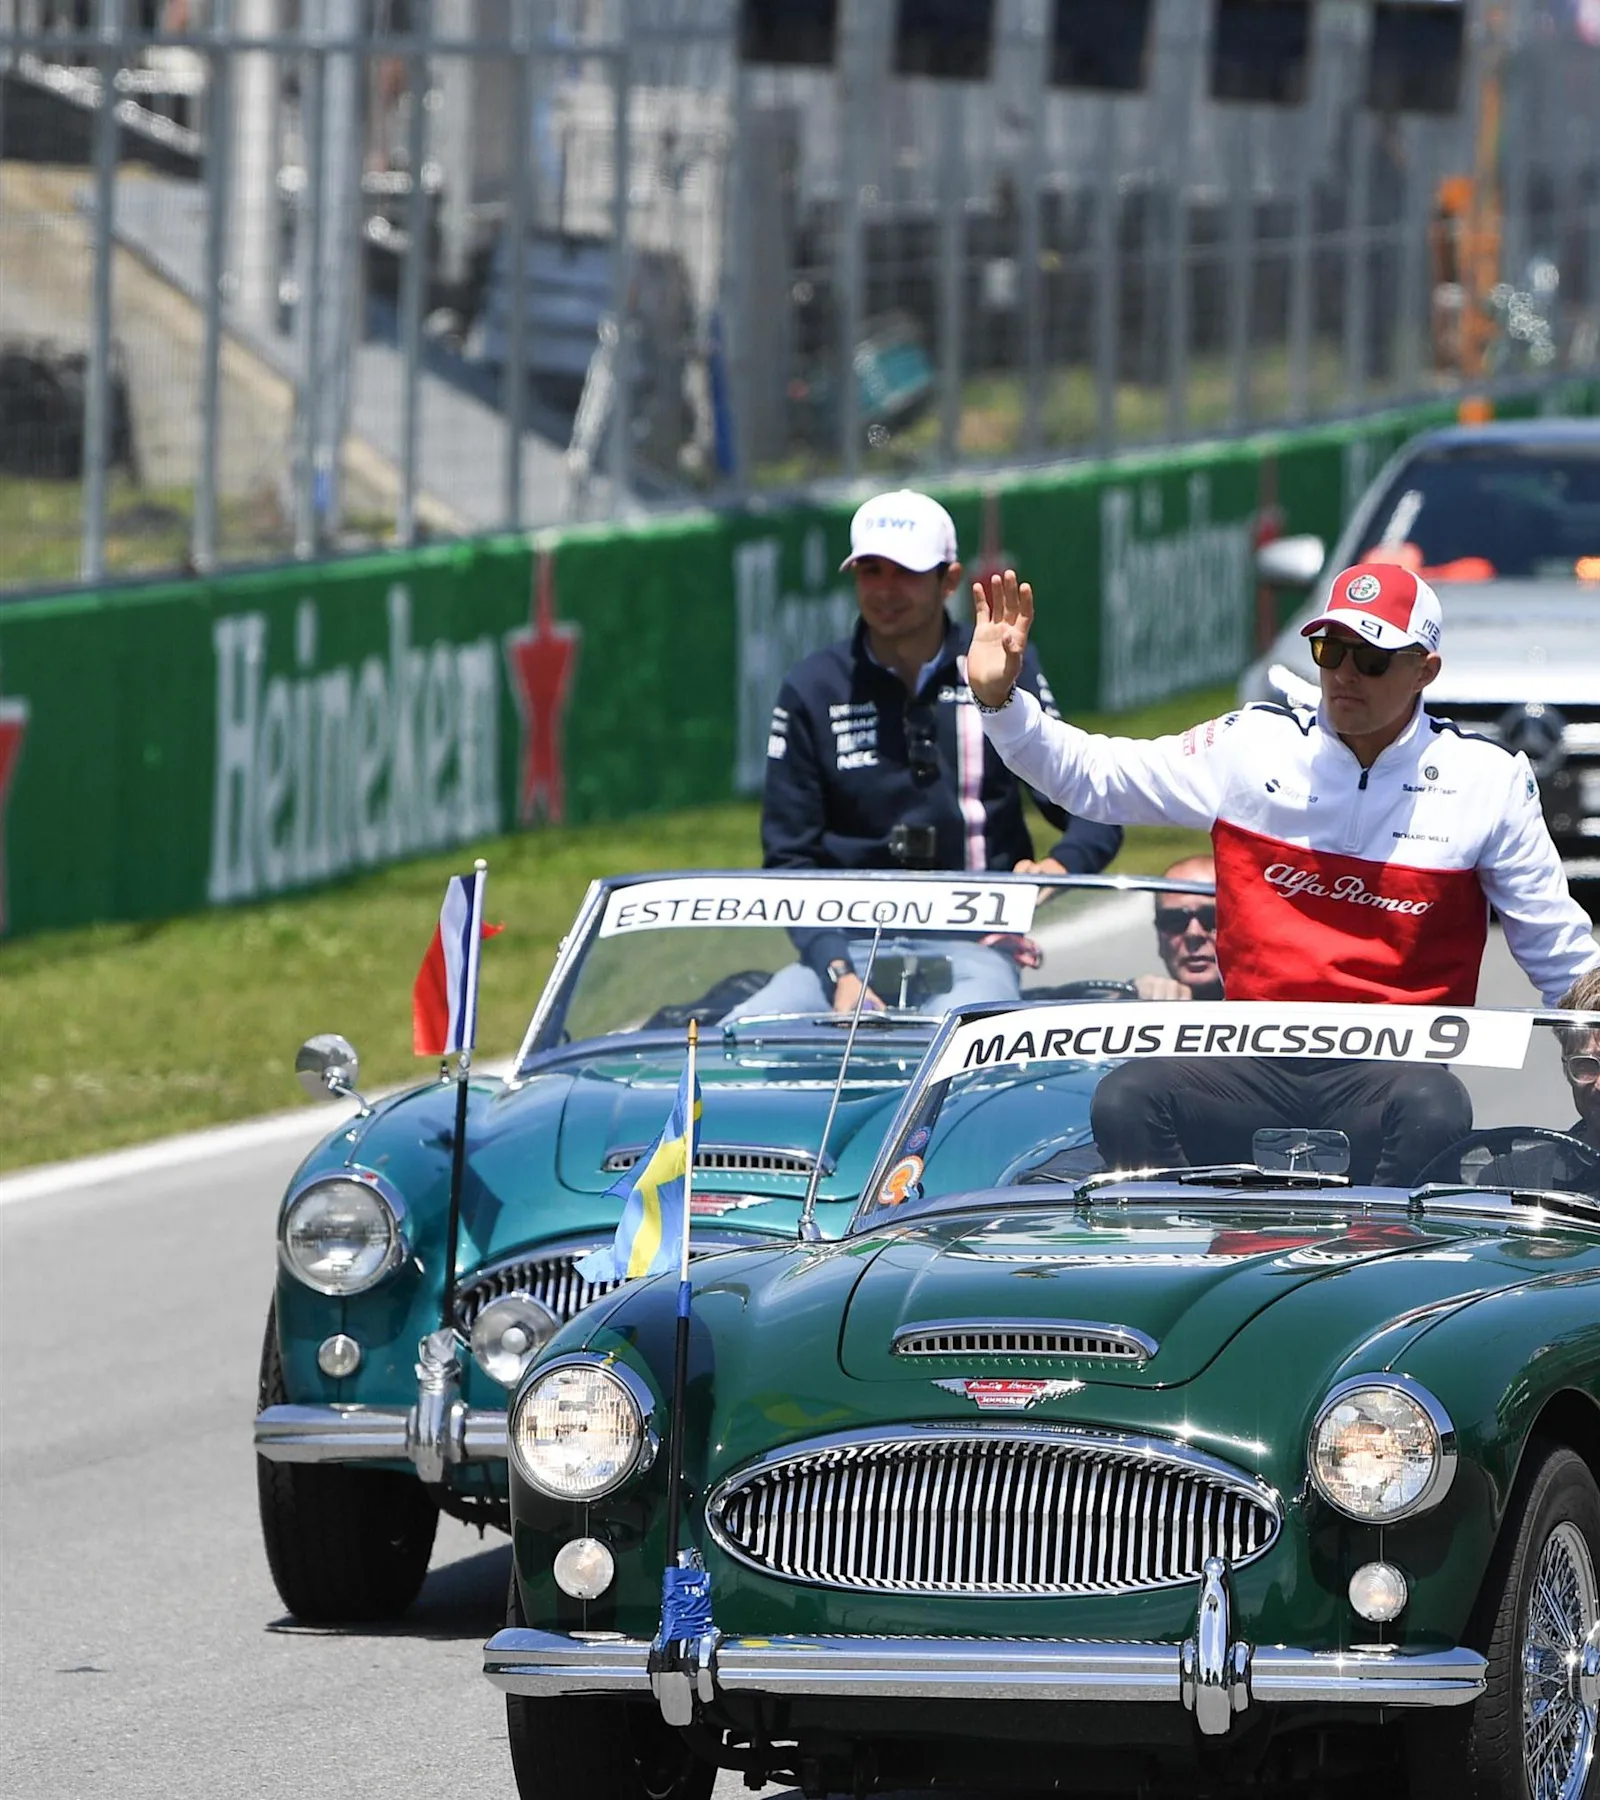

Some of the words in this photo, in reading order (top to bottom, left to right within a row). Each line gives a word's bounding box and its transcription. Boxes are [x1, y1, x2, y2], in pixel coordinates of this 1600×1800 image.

[1360, 619, 1383, 639] 9
[209, 584, 500, 902] Heineken
[837, 751, 880, 771] NEC
[616, 898, 804, 928] ESTEBAN
[817, 900, 933, 925] OCON
[946, 891, 1010, 926] 31
[1264, 863, 1330, 898] Alfa
[1330, 875, 1434, 916] Romeo
[963, 1024, 1164, 1068] MARCUS
[1173, 1024, 1413, 1057] ERICSSON
[1425, 1015, 1471, 1059] 9
